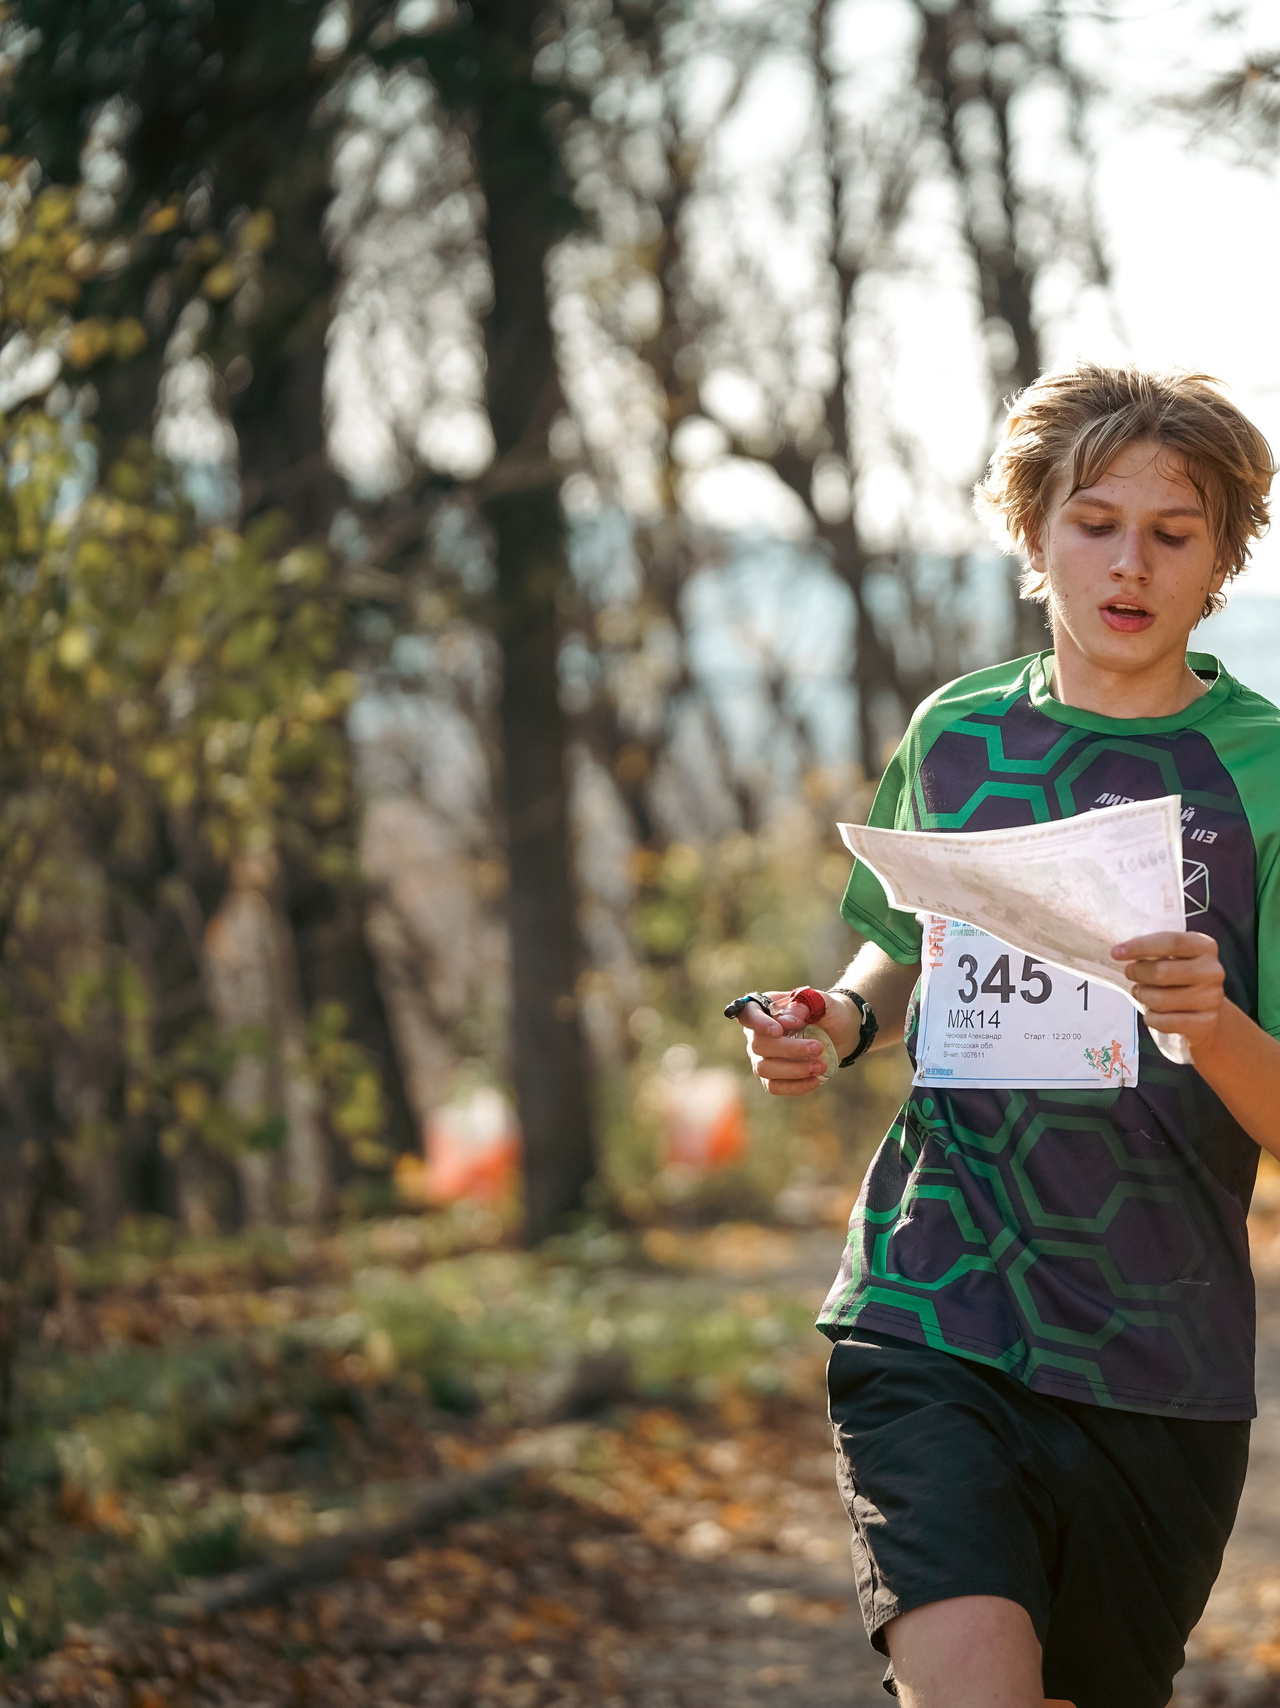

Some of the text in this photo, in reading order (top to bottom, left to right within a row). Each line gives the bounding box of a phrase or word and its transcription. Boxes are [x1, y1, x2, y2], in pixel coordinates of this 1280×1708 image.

[929, 962, 944, 970] 1
[957, 953, 1053, 1004] 345
[1076, 980, 1089, 1011] 1
[947, 1009, 1001, 1029] МЖ14
[968, 1033, 1003, 1041] Александр
[1024, 1032, 1046, 1041] Старт
[1052, 1032, 1082, 1040] 12:20:00
[943, 1041, 995, 1050] Белгородская обл.
[960, 1051, 985, 1059] 1007611
